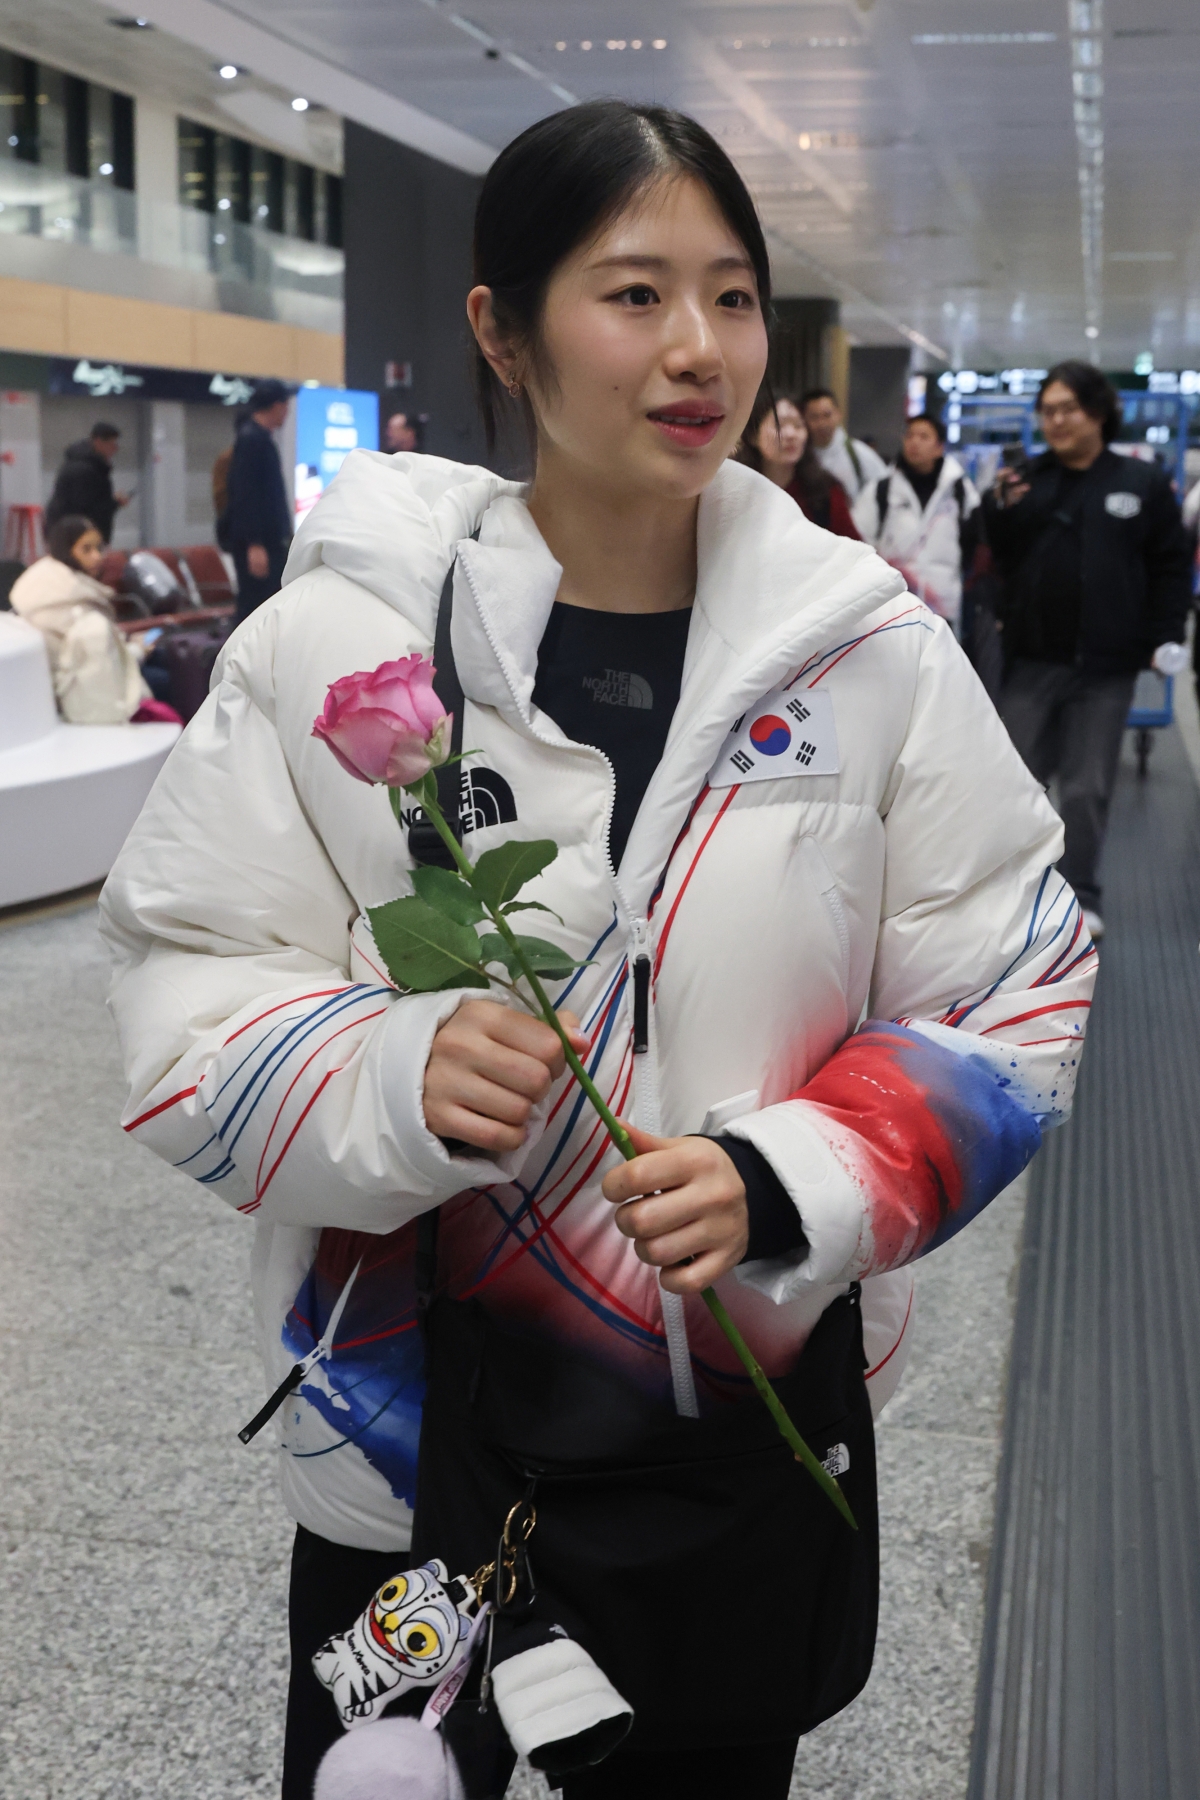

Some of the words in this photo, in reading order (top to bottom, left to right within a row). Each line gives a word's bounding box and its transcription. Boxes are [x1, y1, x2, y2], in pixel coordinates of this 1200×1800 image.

[604, 669, 630, 683] THE
[582, 676, 629, 695] NORTH
[593, 690, 627, 706] FACE
